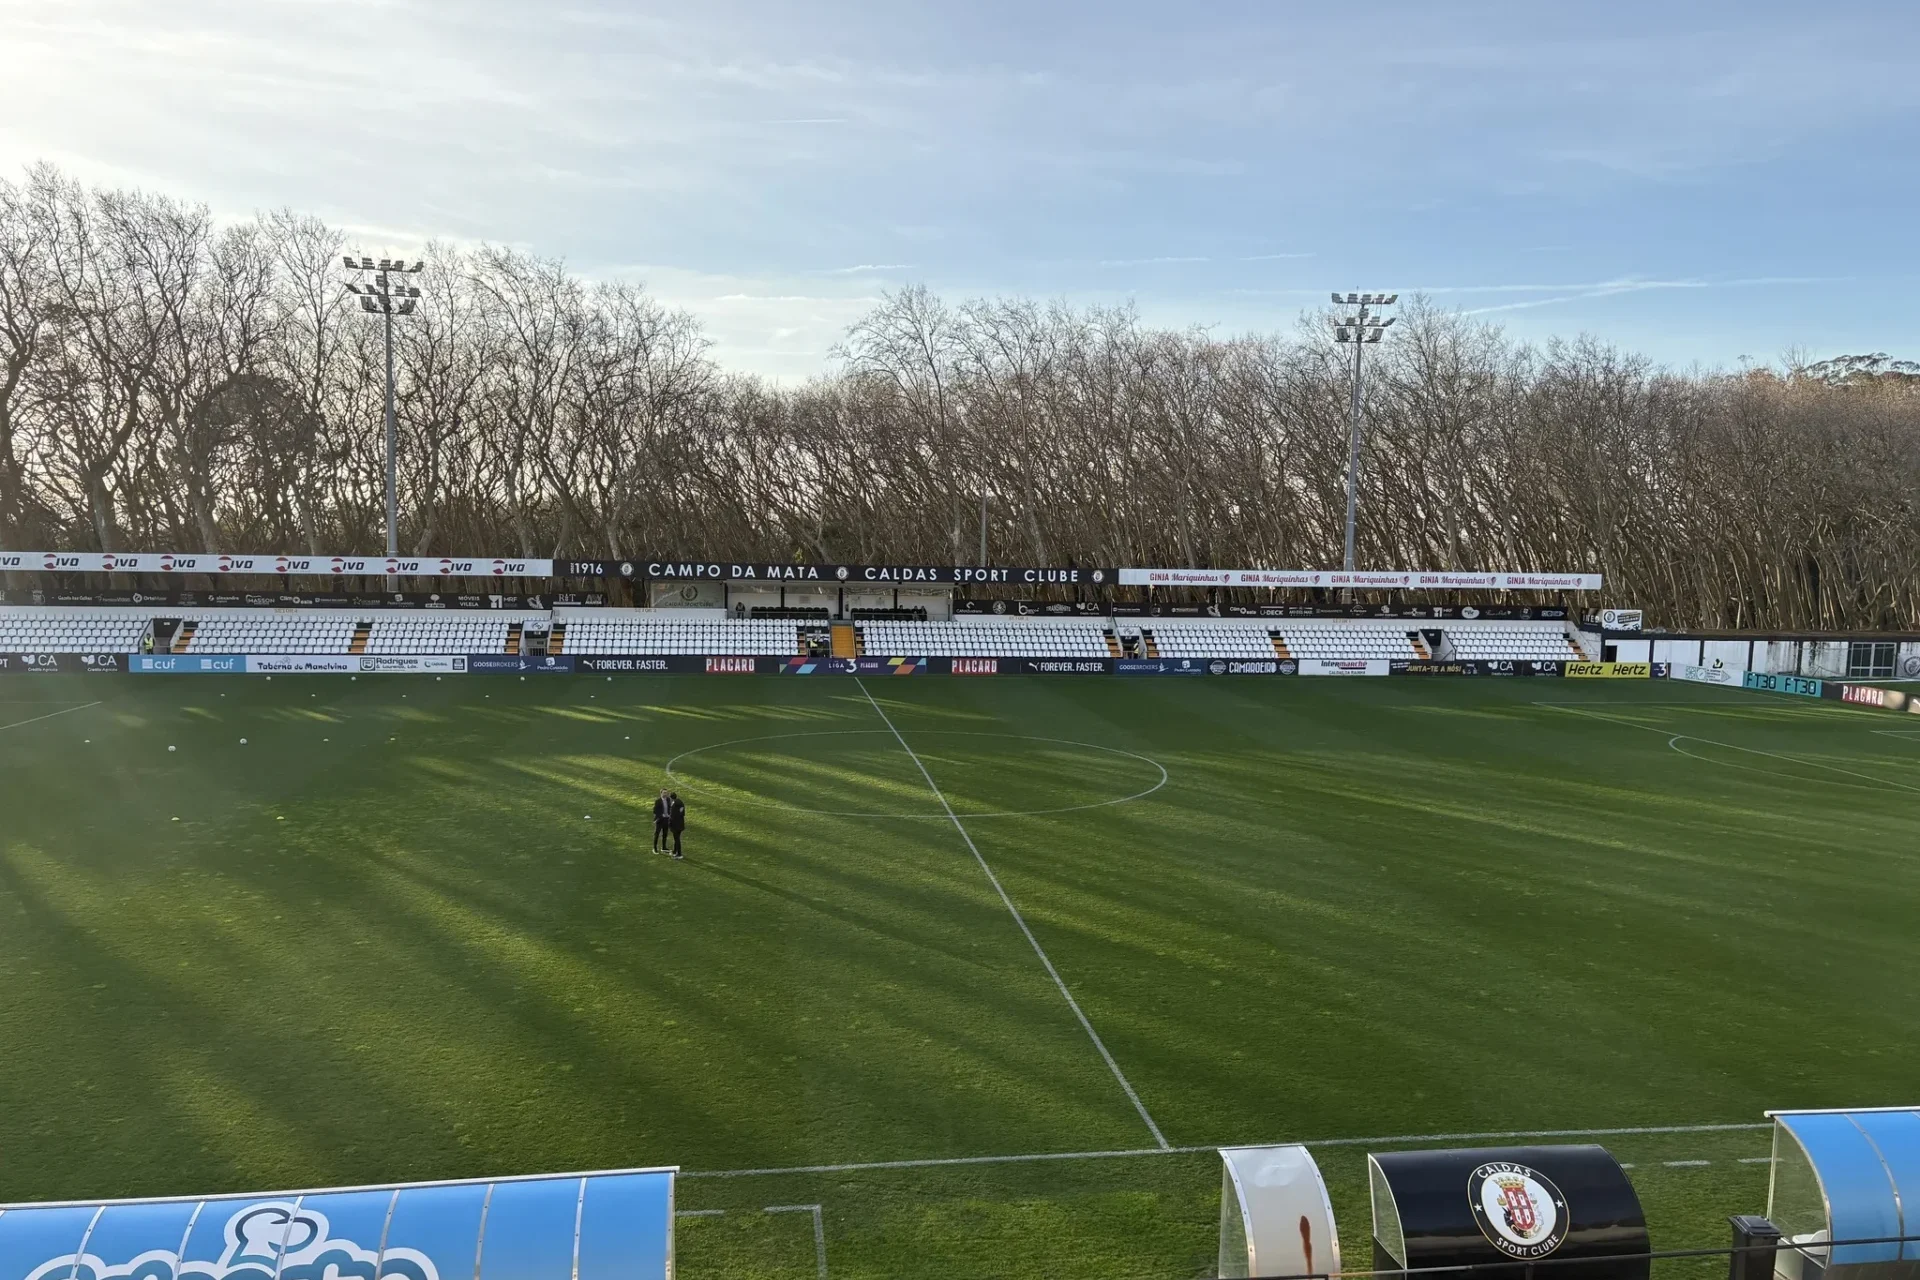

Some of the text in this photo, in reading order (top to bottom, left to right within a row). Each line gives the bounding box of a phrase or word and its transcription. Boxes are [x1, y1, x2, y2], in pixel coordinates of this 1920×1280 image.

[56, 558, 79, 566] IVO
[115, 558, 138, 567] IVO
[173, 559, 196, 568] IVO
[230, 560, 253, 568] IVO
[287, 561, 310, 570] IVO
[342, 562, 365, 570] IVO
[397, 562, 419, 571] IVO
[451, 563, 472, 571] IVO
[504, 564, 525, 572] IVO
[575, 562, 603, 574] 1916
[649, 563, 818, 579] CAMPO DA MATA
[865, 567, 1078, 582] CALDAS SPORT CLUBE
[1172, 573, 1218, 583] Mariquinhas
[1241, 574, 1308, 584] GINJA Mariquinhas
[1353, 576, 1398, 585] Mariquinhas
[1441, 576, 1485, 585] Mariquinhas
[1527, 576, 1570, 586] Mariquinhas
[1087, 603, 1099, 611] CA
[38, 655, 57, 666] CA
[98, 655, 117, 666] CA
[154, 658, 175, 669] cuf
[213, 659, 234, 669] cuf
[597, 660, 668, 670] FOREVER. FASTER.
[706, 658, 755, 672] PLACARD
[845, 659, 857, 673] 3
[952, 660, 997, 673] PLACARD
[1041, 662, 1104, 672] FOREVER. FASTER.
[1500, 661, 1513, 671] CA
[1543, 662, 1557, 671] CA
[1568, 664, 1602, 674] Hertz
[1612, 665, 1646, 675] Hertz
[1747, 673, 1776, 689] FT30
[1785, 678, 1816, 695] FT30
[1843, 686, 1883, 705] PLACARD
[1477, 1164, 1531, 1178] CALDAS
[1497, 1234, 1559, 1256] SPORT CLUBE
